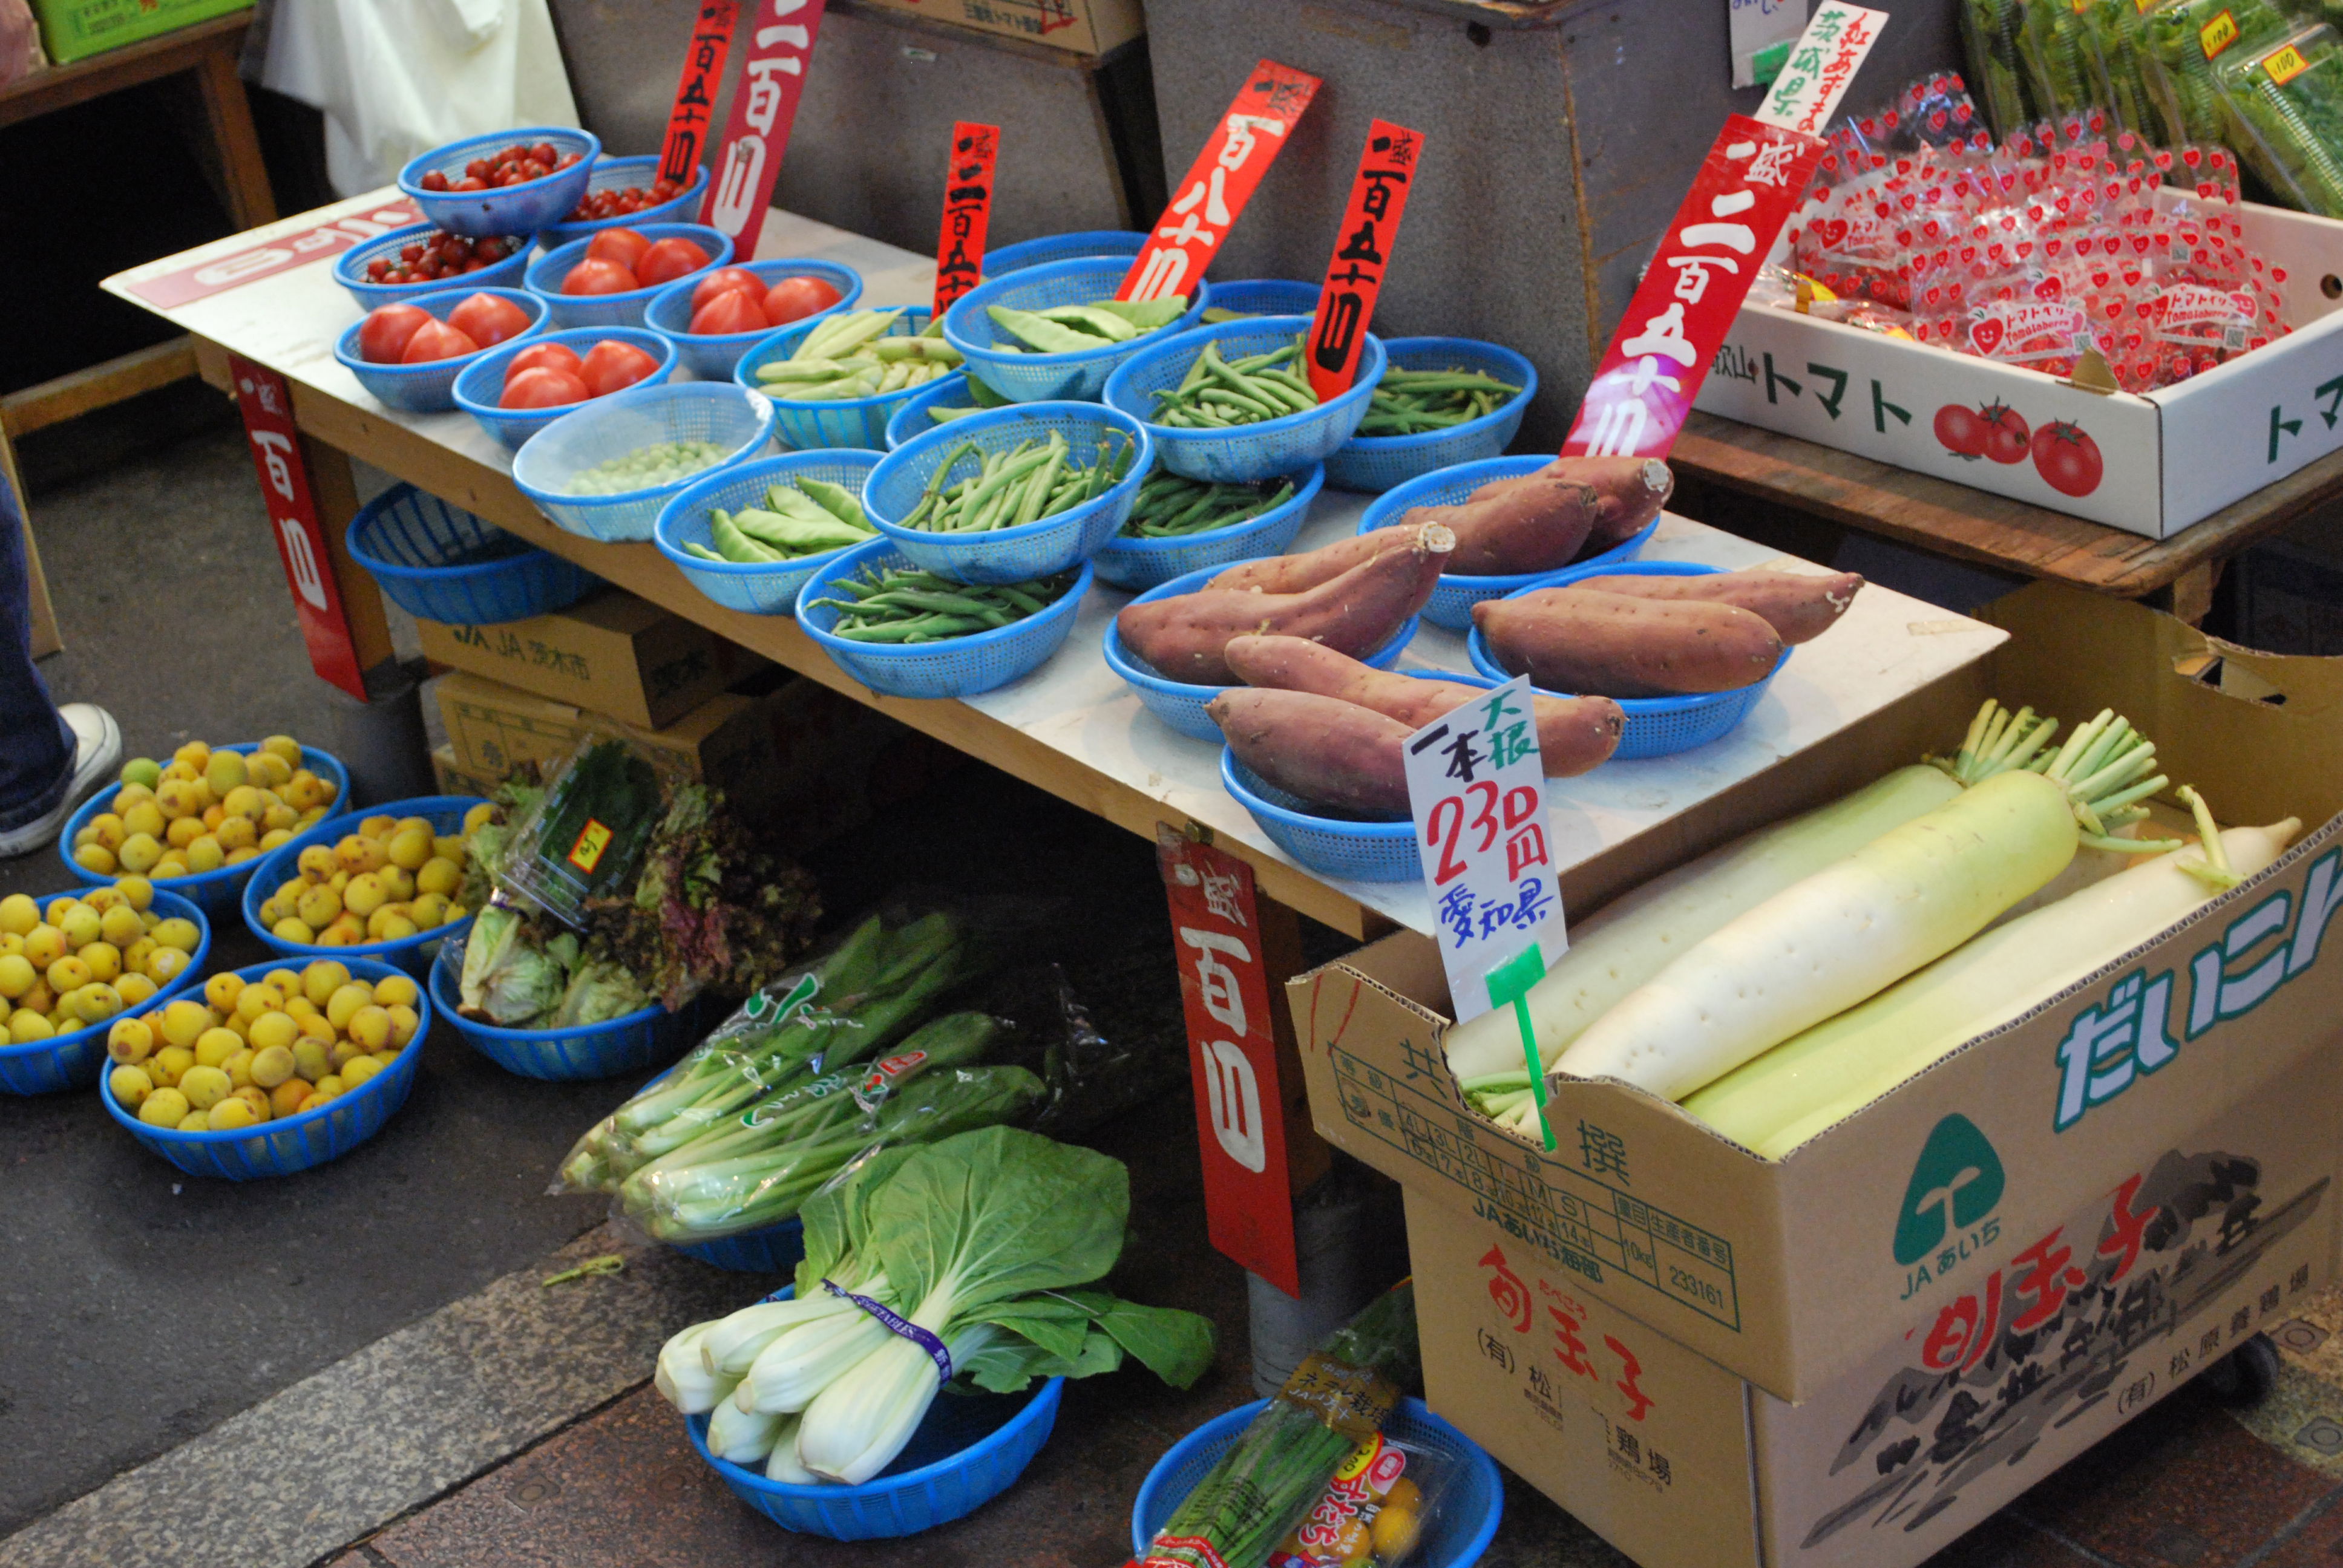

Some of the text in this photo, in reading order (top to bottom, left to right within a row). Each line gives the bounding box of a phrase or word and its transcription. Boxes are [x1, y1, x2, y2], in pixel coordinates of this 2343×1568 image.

[1773, 10, 1846, 116] 茨城県
[1763, 351, 1912, 434] トマト
[1411, 724, 1487, 782] 一本
[1480, 688, 1541, 771] 大根
[1426, 780, 1539, 886] 230
[1438, 877, 1555, 949] 愛知県
[1670, 1266, 1724, 1310] 233161
